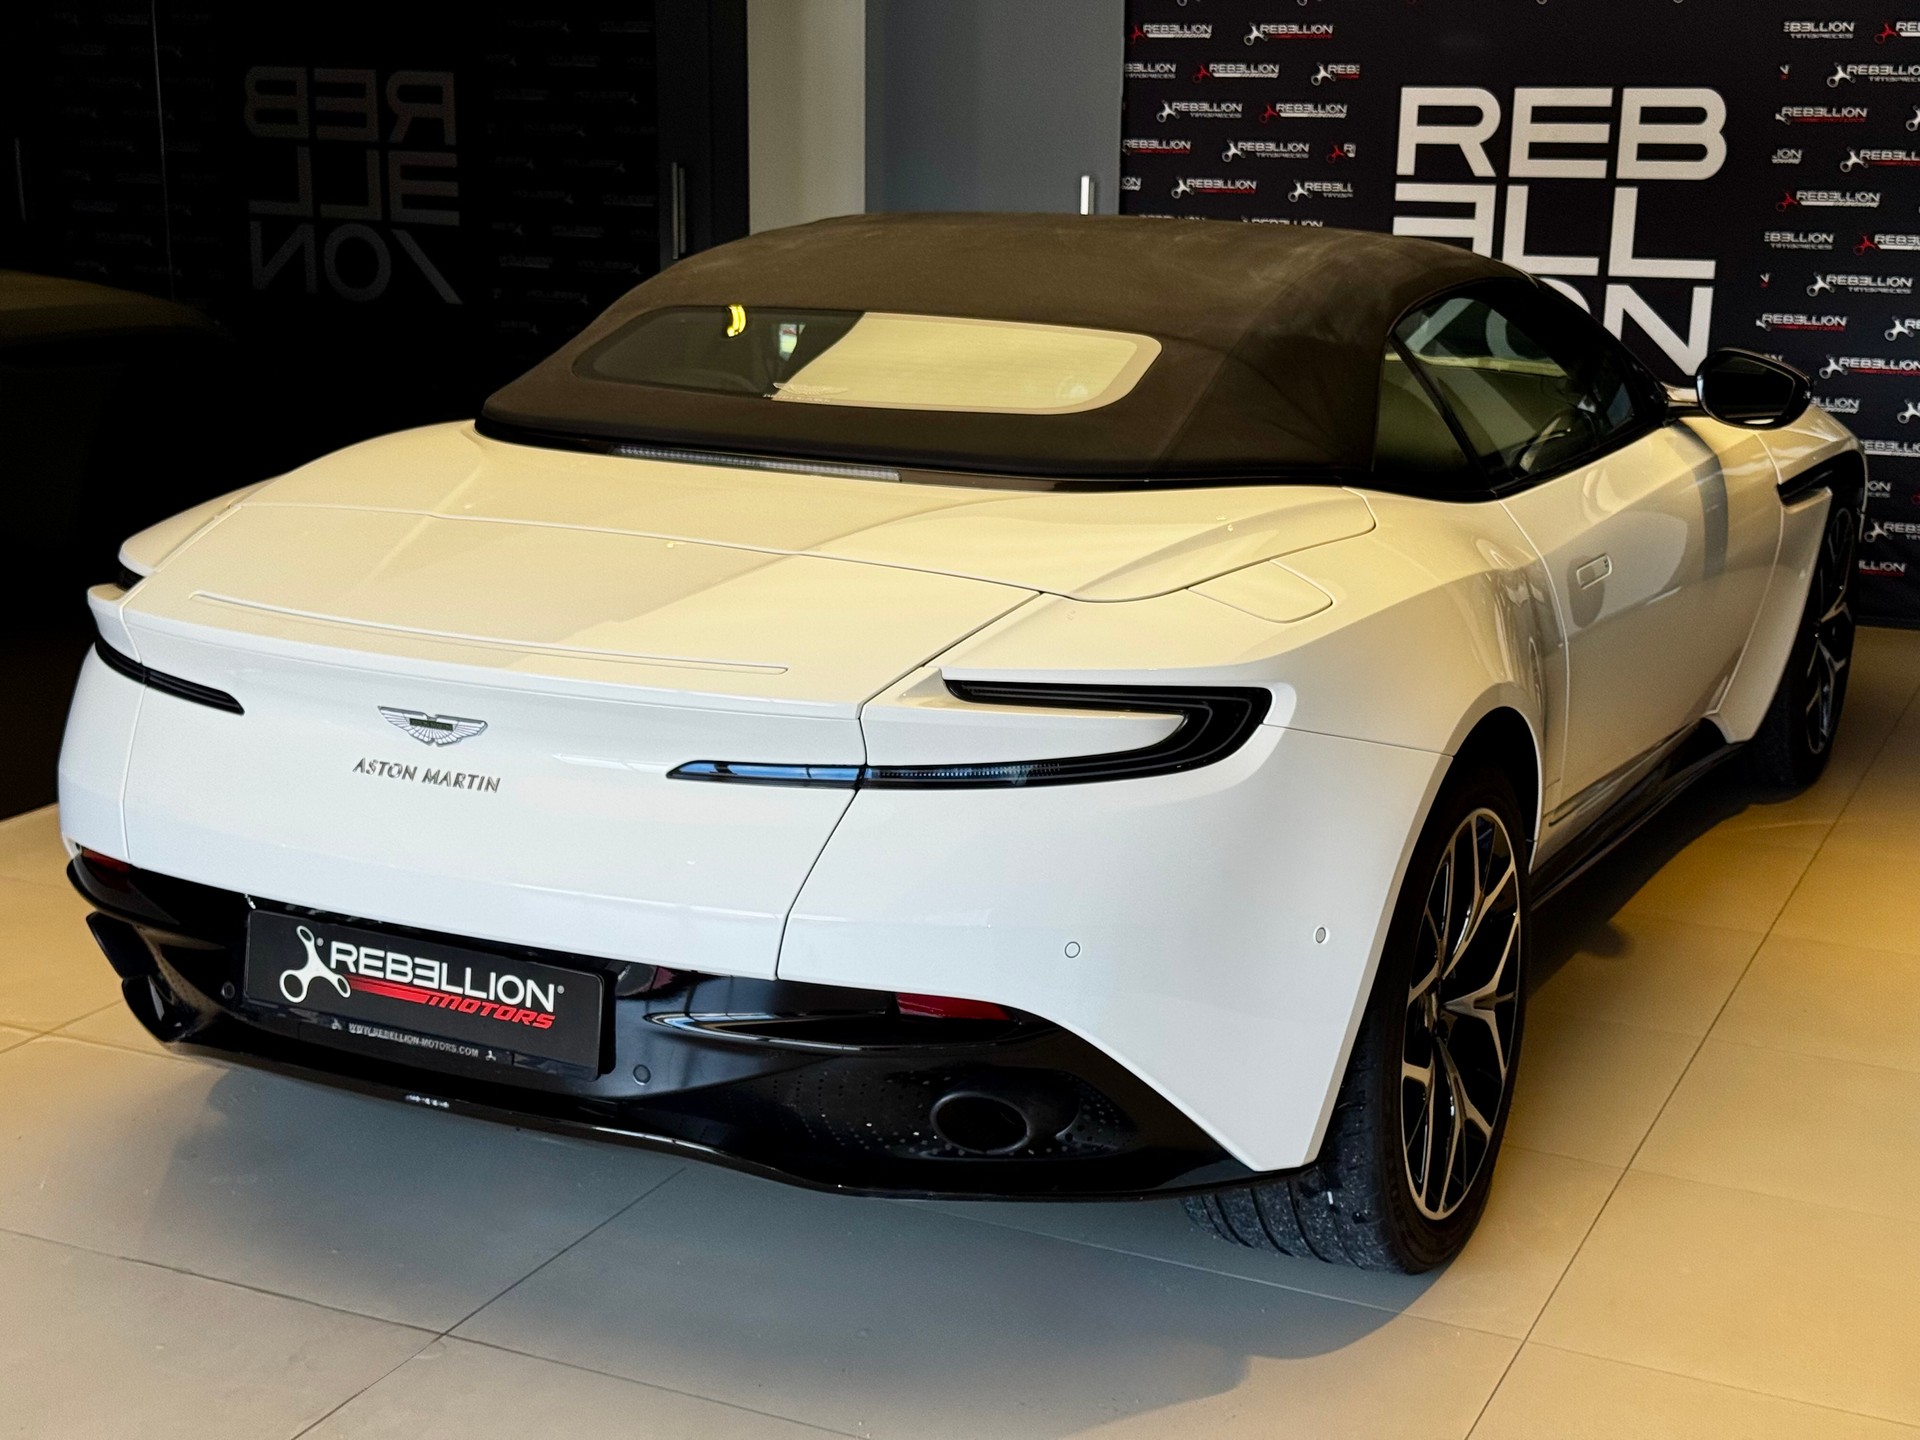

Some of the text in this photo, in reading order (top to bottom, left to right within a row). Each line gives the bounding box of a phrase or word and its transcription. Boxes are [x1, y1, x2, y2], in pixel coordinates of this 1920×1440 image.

[1396, 86, 1728, 180] REB
[352, 757, 501, 794] ASTON MARTIN
[426, 992, 556, 1030] MOTORS
